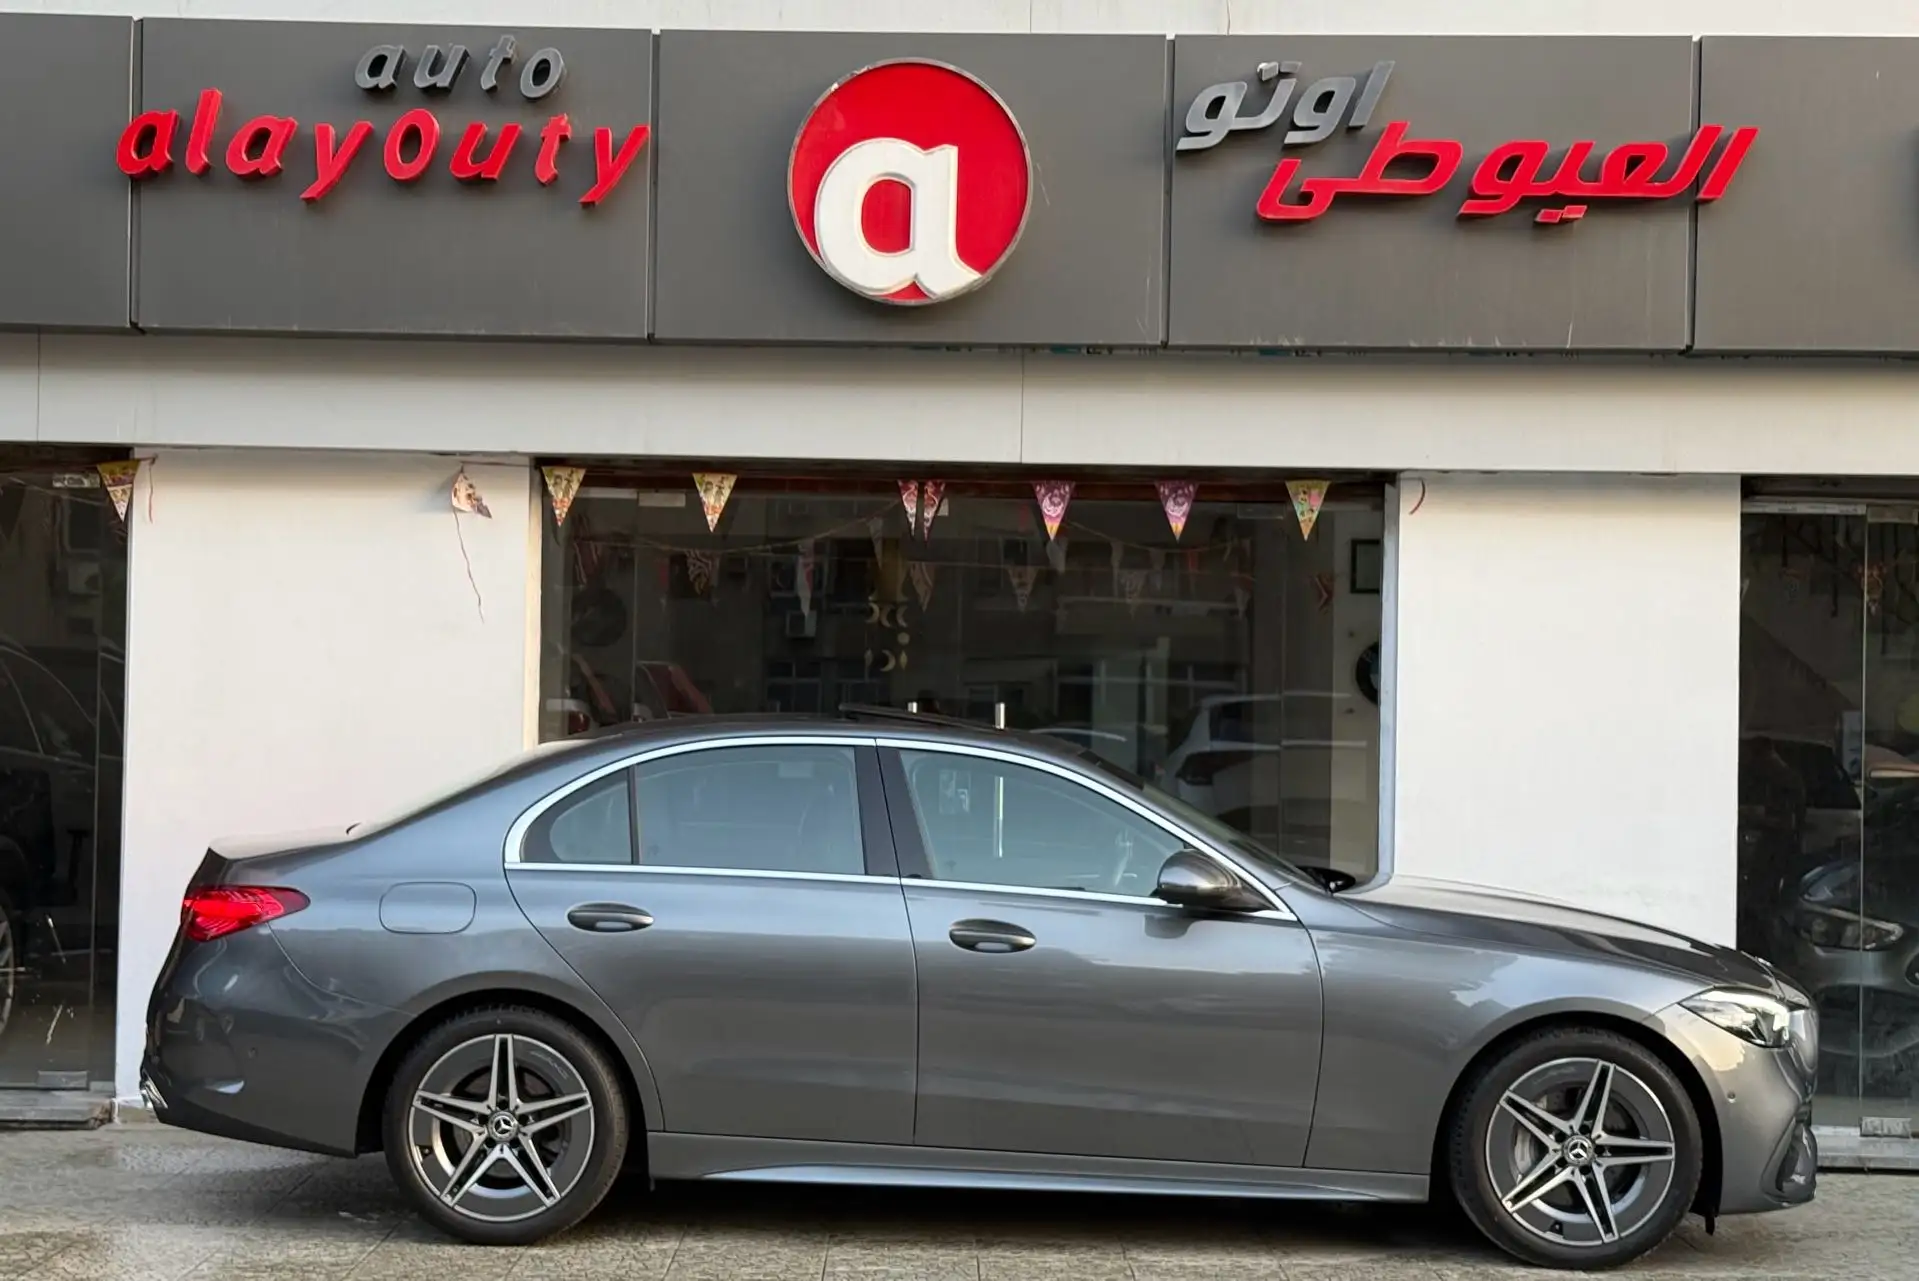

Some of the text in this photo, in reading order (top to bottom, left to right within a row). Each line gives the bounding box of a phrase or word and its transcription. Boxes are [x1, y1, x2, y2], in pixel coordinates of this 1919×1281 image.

[355, 34, 568, 99] auto
[115, 88, 652, 206] alayouty
[813, 136, 984, 299] a
